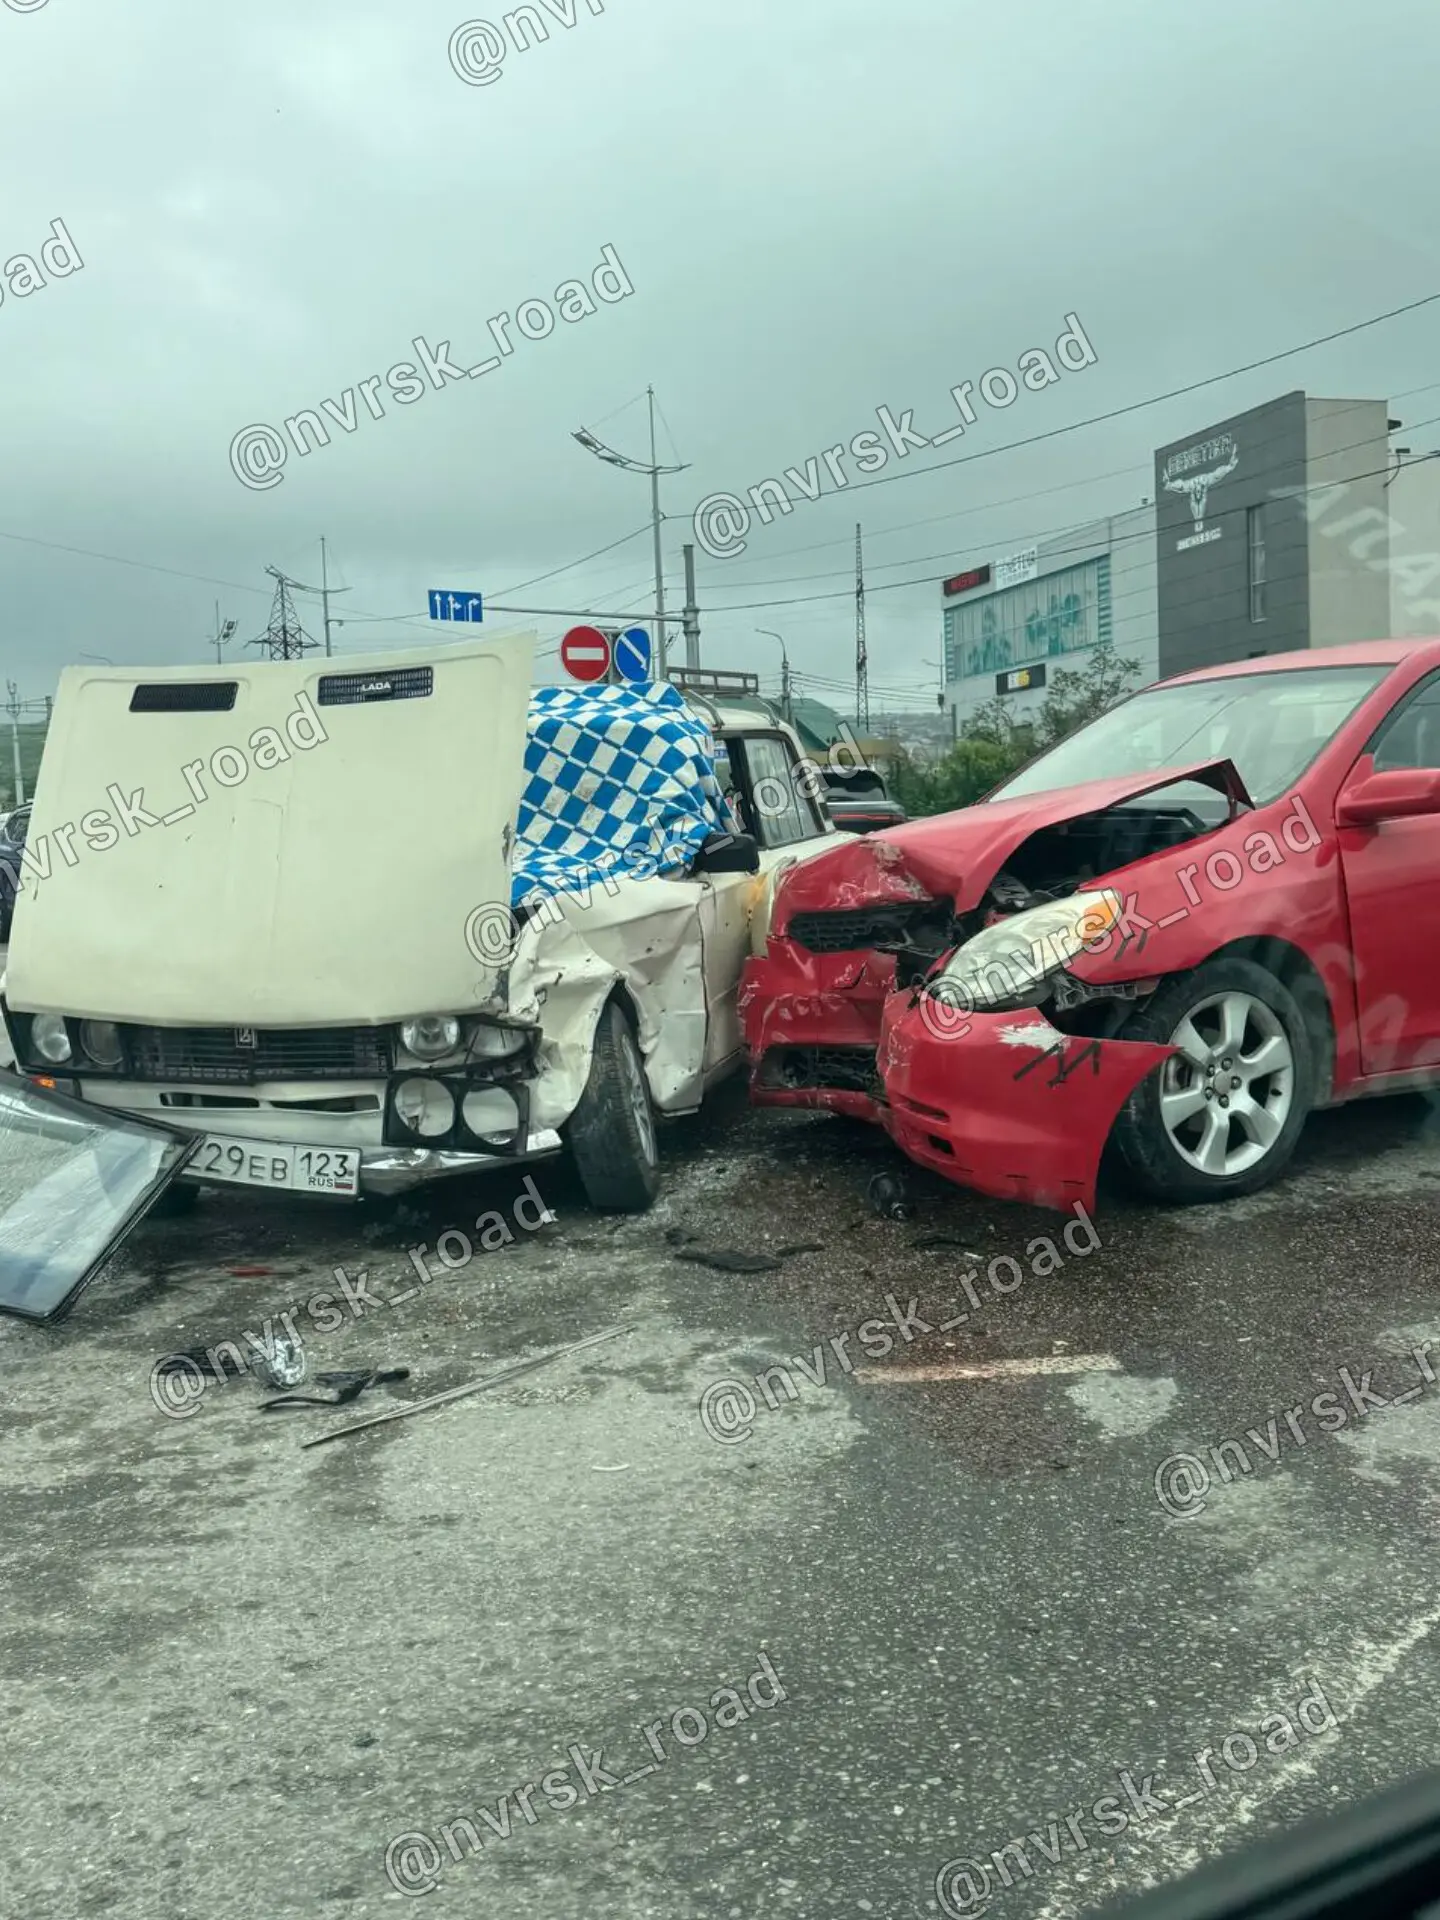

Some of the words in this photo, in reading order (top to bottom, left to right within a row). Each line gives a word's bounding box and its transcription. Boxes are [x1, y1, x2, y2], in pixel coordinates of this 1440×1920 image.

[362, 681, 392, 692] LADA
[188, 1142, 288, 1182] 29ЕВ
[300, 1151, 349, 1178] 123
[308, 1176, 334, 1188] RUS
